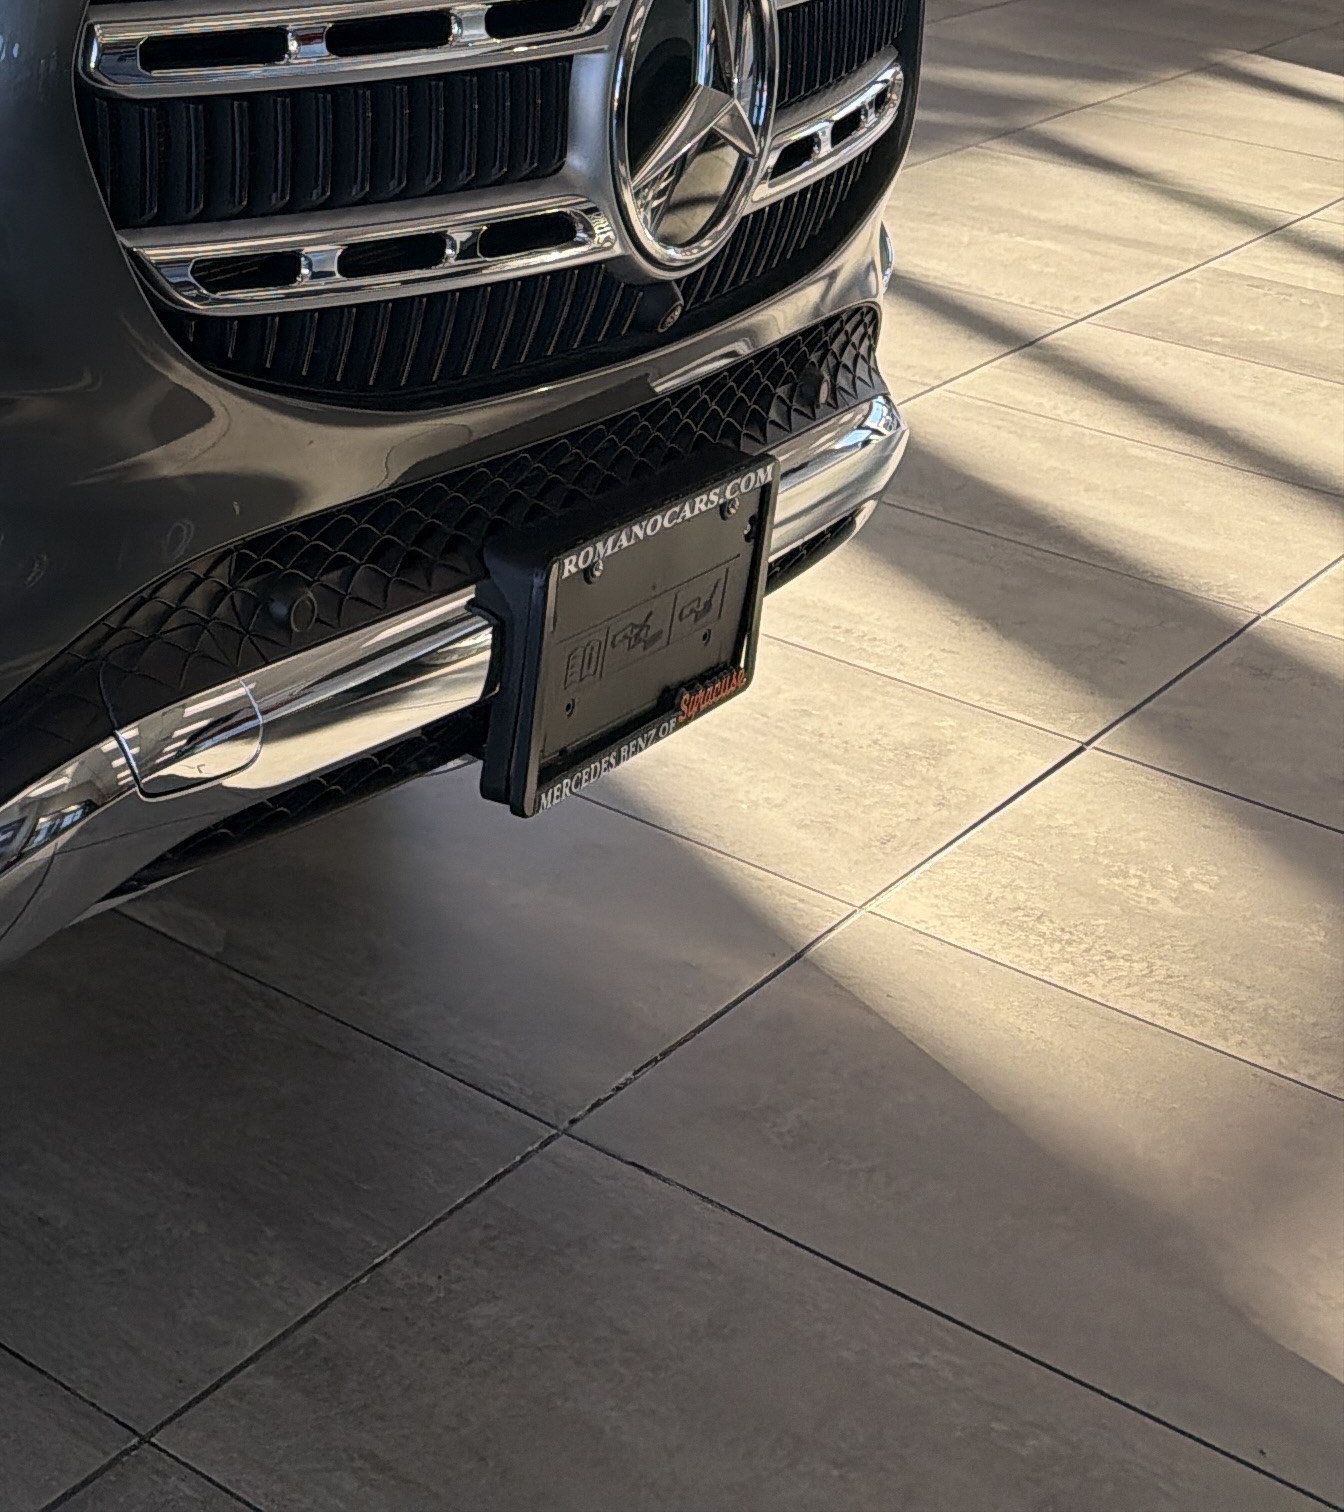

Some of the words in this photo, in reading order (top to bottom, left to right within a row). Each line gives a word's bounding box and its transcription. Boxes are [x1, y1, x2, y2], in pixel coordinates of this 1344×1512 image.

[561, 462, 775, 580] ROMANOCARS.COM
[537, 749, 617, 814] MERCEDES
[619, 727, 657, 765] BENZ
[658, 716, 678, 739] OF
[678, 668, 747, 722] Syracuse
